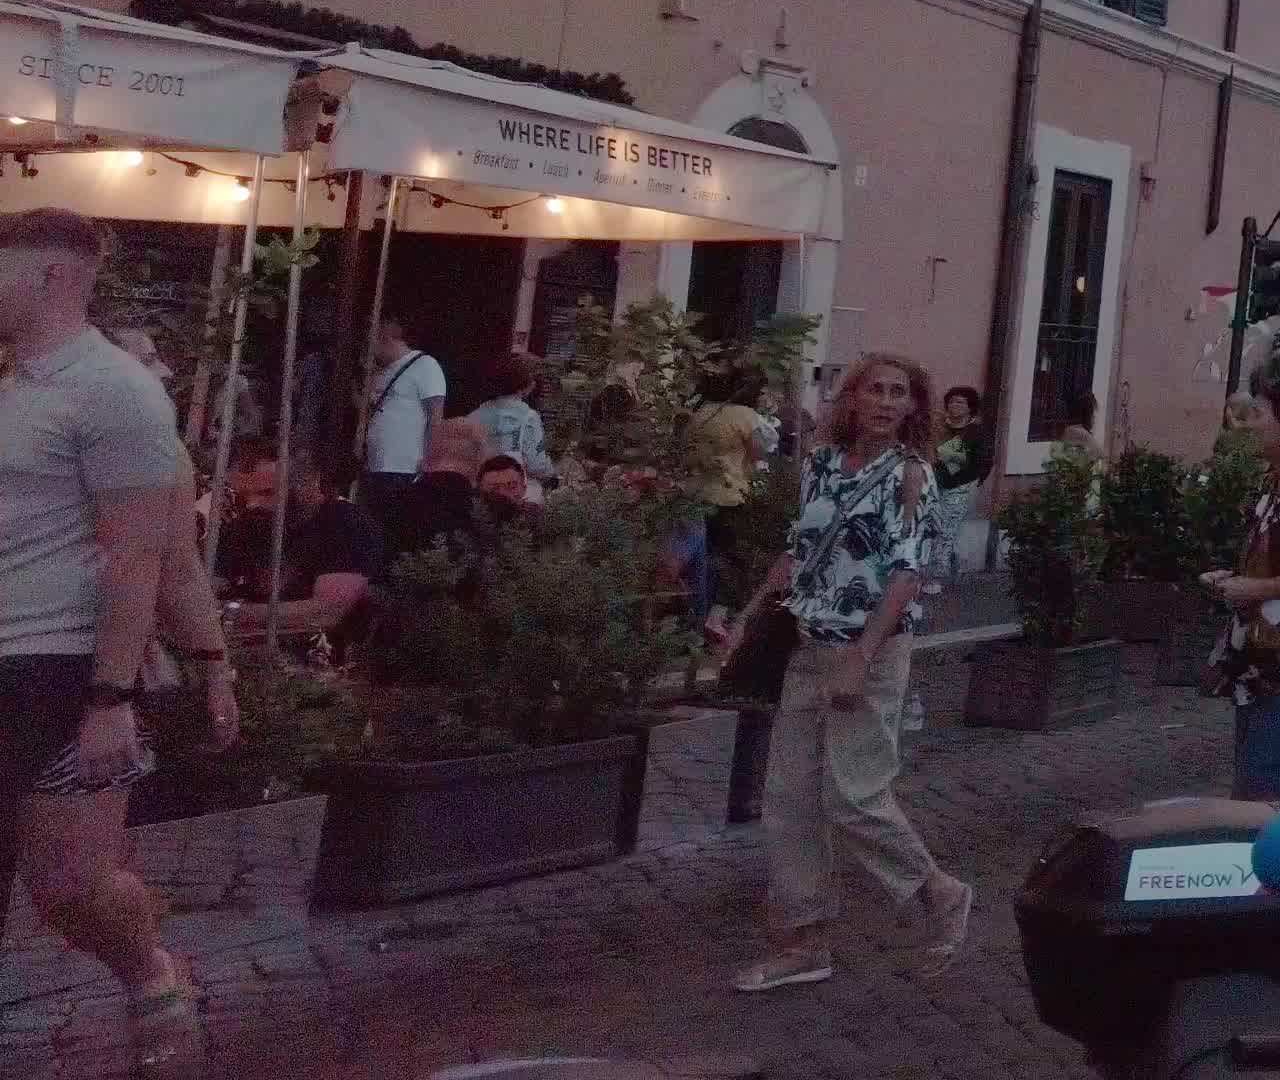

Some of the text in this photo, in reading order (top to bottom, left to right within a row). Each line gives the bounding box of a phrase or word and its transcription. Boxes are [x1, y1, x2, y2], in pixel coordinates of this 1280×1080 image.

[19, 55, 185, 97] SICE 2001
[472, 149, 520, 170] Breakfast
[499, 119, 713, 176] WHERE LIFE IS BETTER
[1139, 873, 1233, 889] FREENOW
